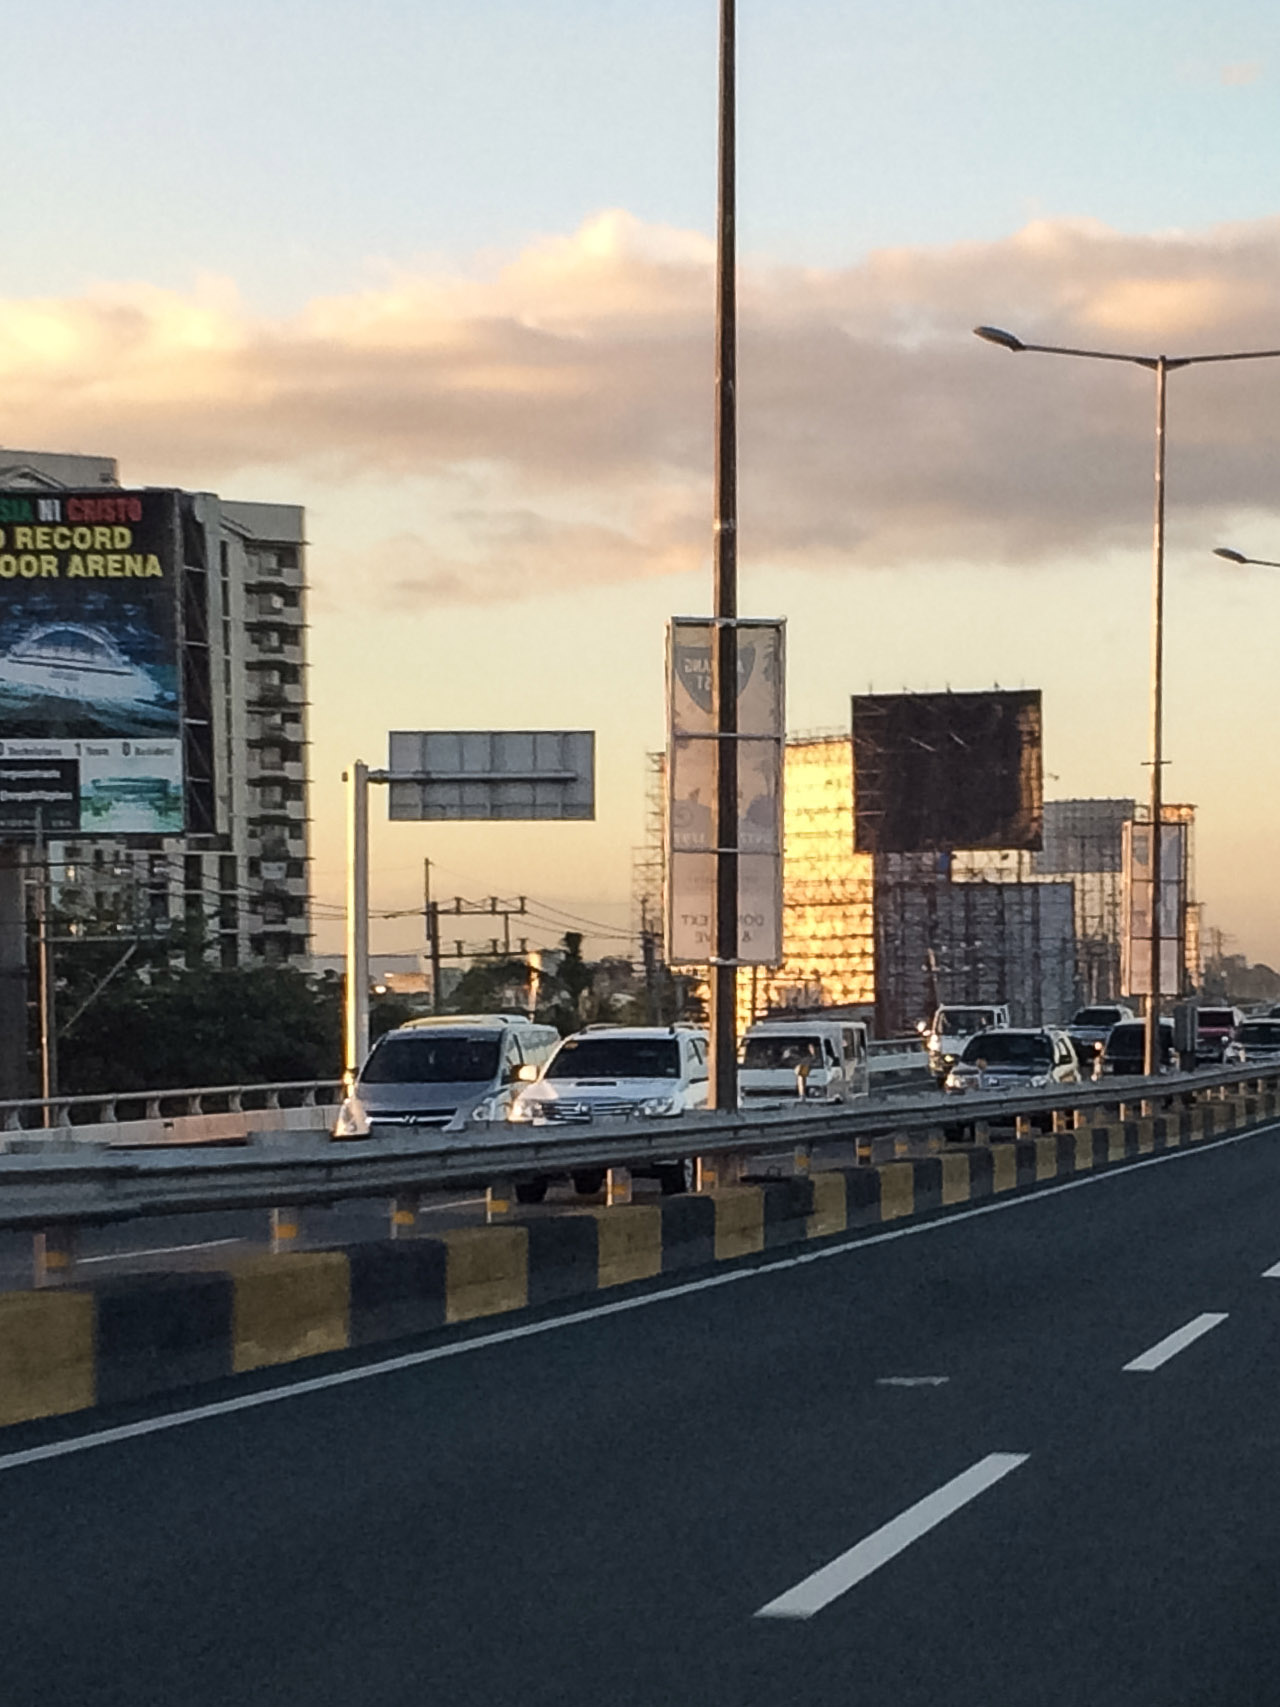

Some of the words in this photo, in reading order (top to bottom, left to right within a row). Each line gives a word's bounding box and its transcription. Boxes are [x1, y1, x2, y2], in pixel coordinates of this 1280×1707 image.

[67, 498, 142, 521] CRISTO
[14, 526, 132, 549] RECORD
[0, 554, 59, 578] OOR
[66, 554, 163, 577] ARENA
